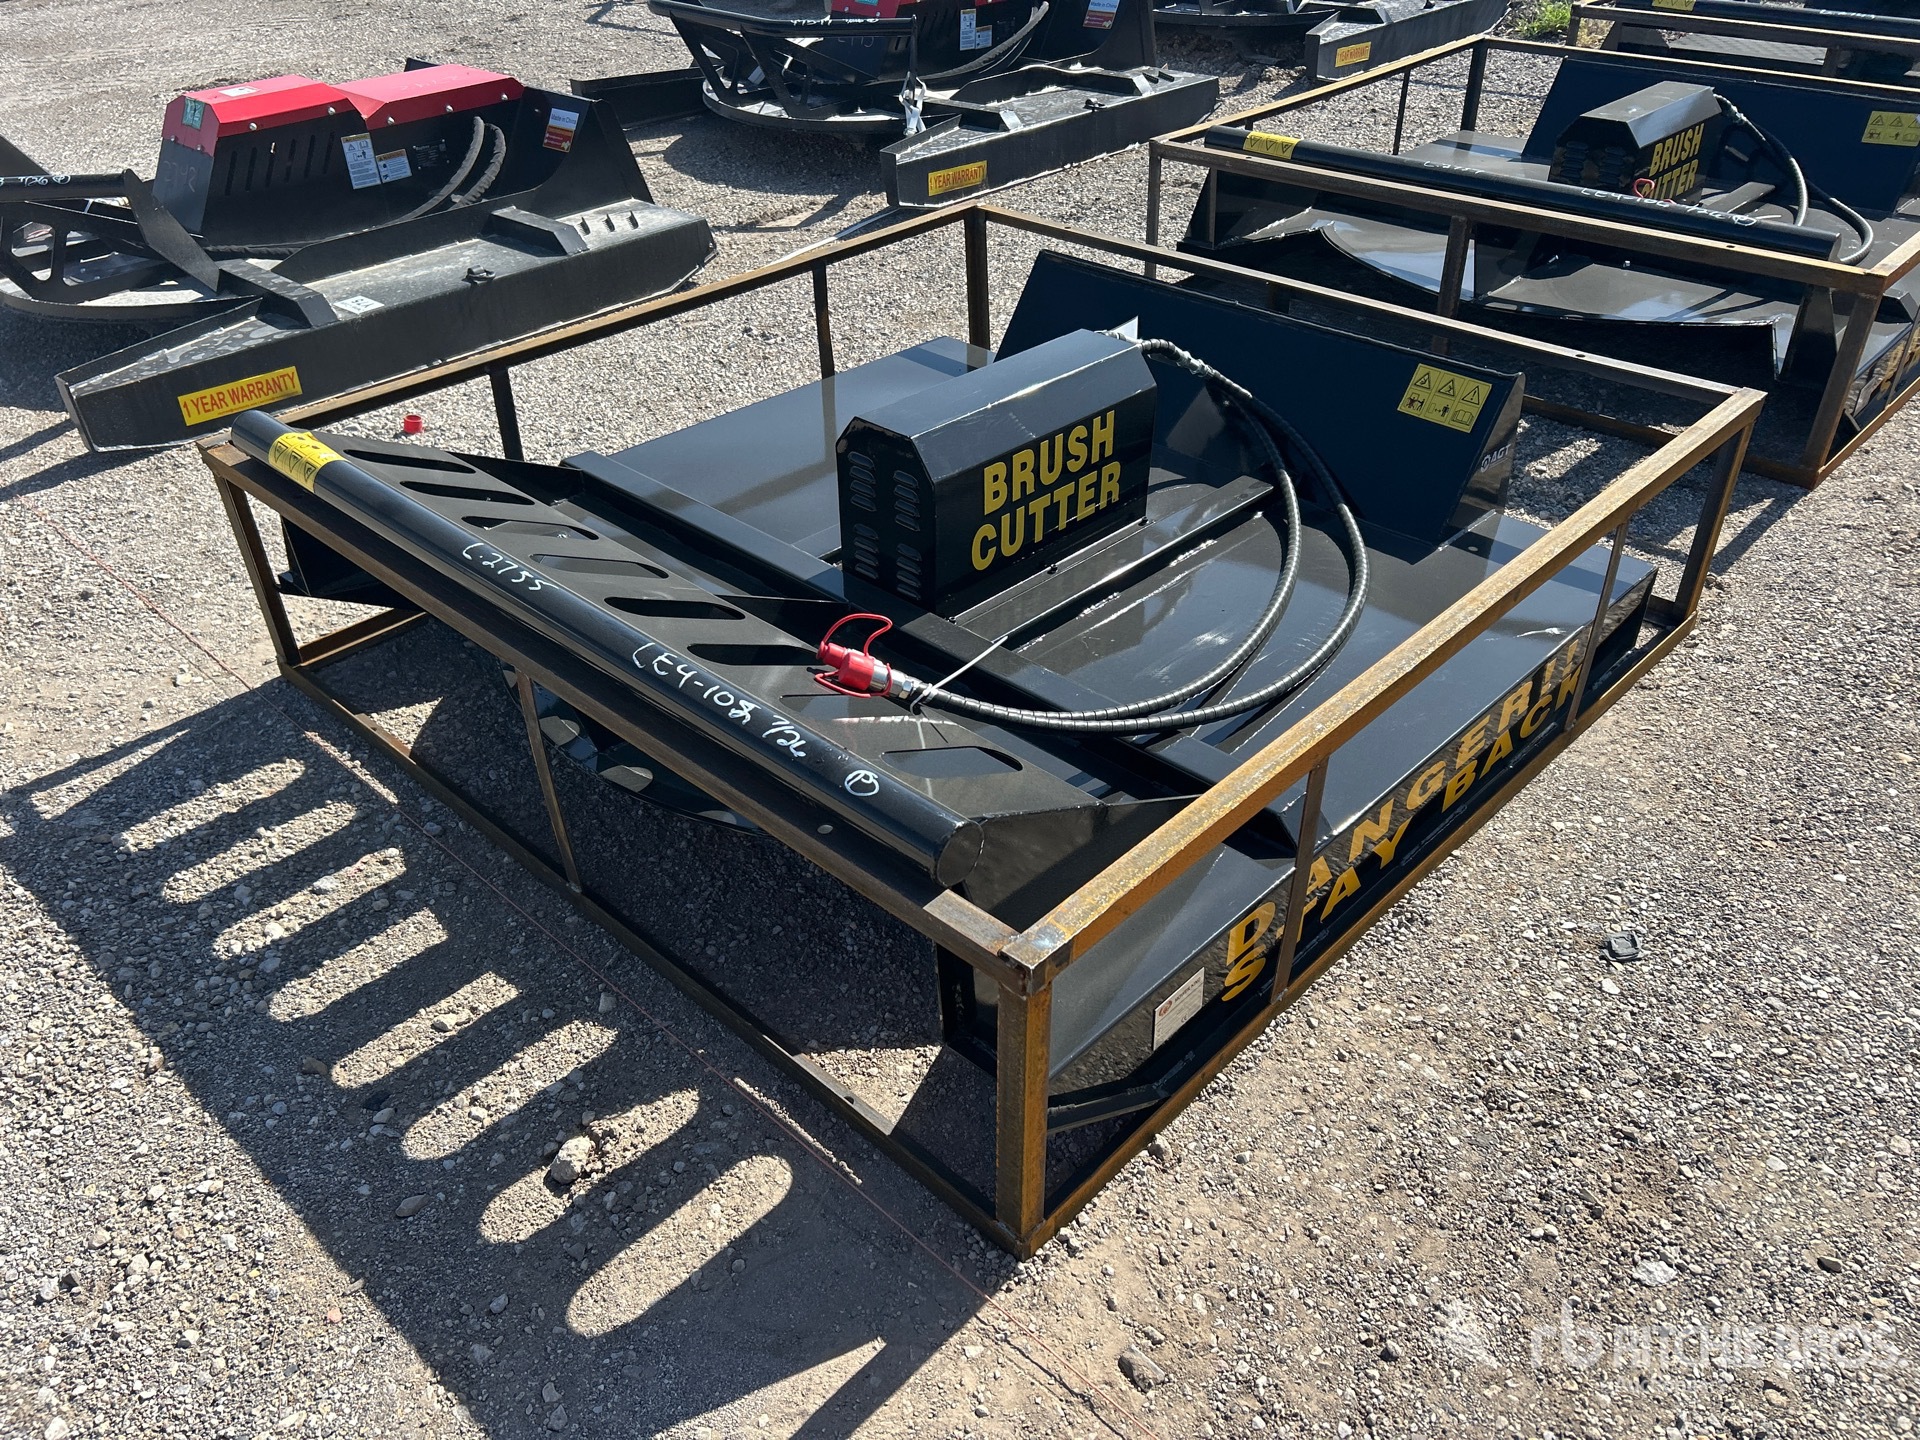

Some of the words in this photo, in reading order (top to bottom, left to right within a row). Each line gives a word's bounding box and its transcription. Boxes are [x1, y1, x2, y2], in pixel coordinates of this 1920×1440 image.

[1649, 123, 1705, 177] BRUSH
[183, 401, 191, 418] 1
[191, 391, 229, 416] YEAR
[227, 372, 296, 405] WARRANTY
[983, 409, 1115, 516] BRUSH
[971, 461, 1122, 572] CUTTER
[1441, 664, 1584, 813] BACK
